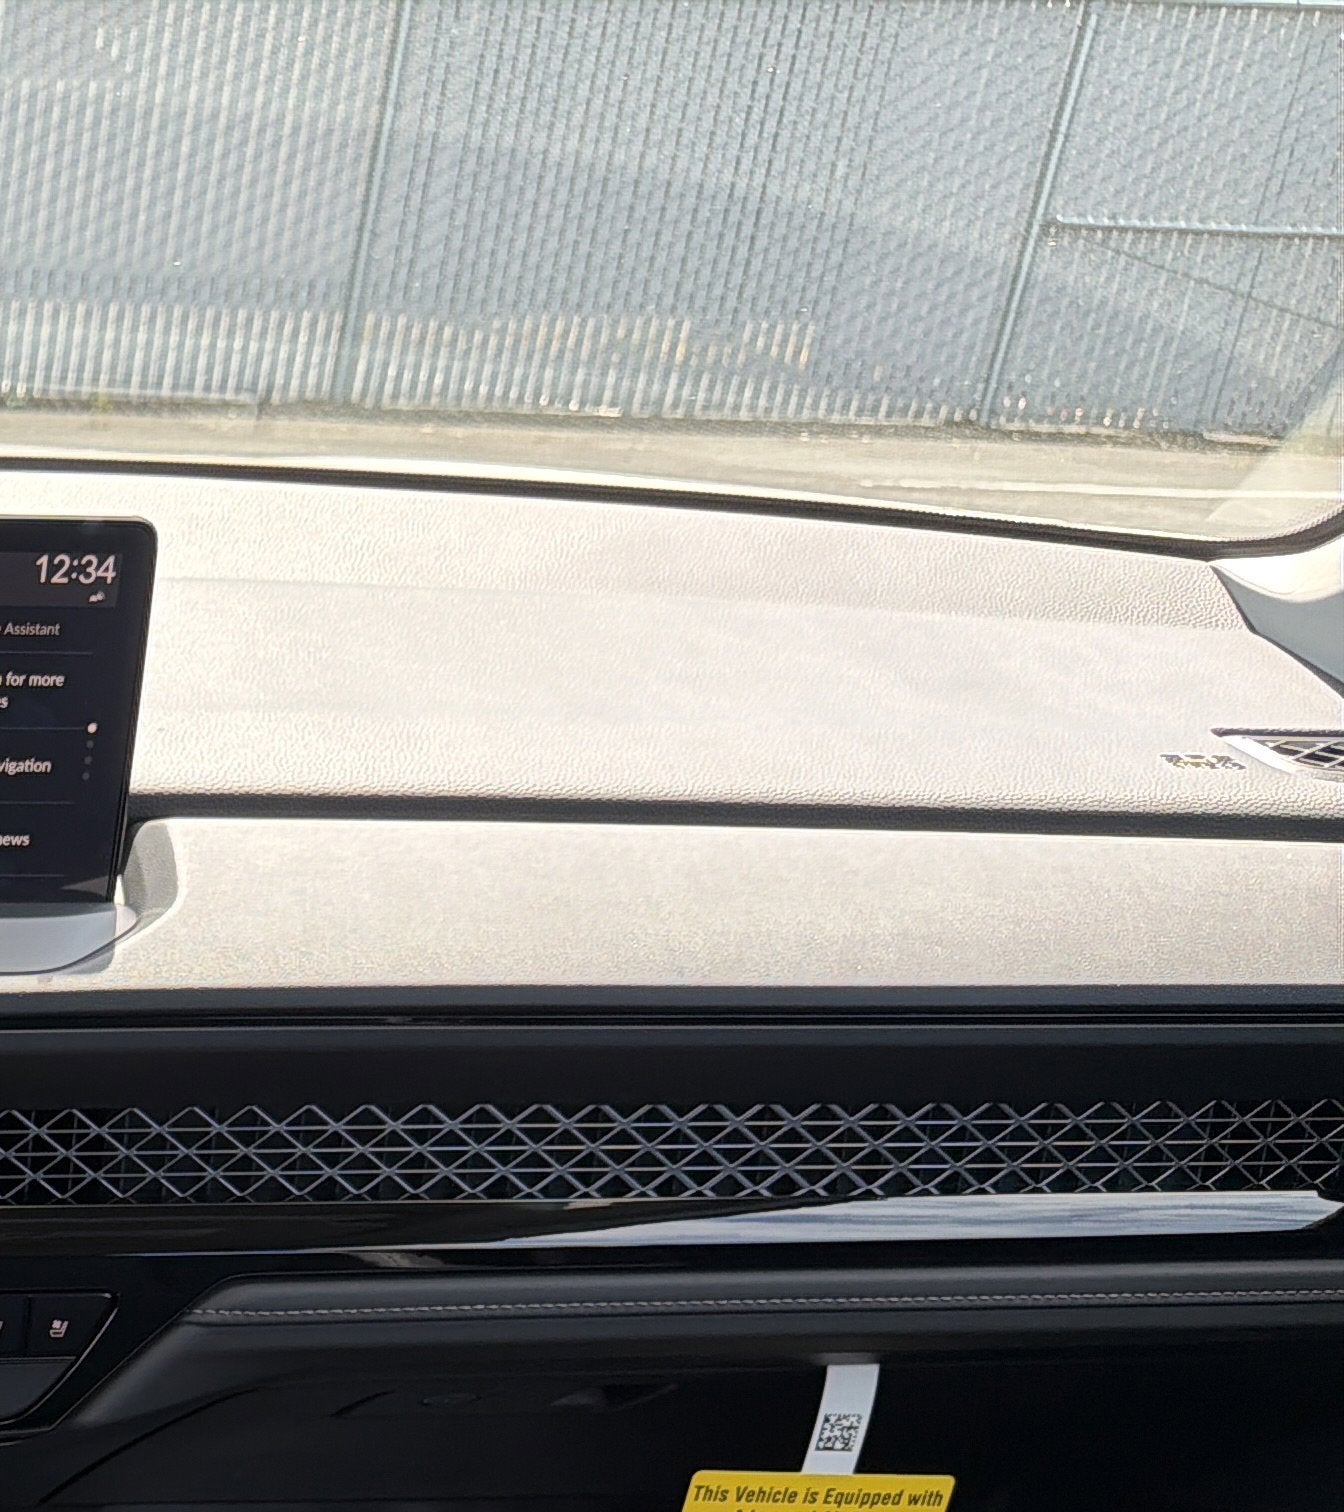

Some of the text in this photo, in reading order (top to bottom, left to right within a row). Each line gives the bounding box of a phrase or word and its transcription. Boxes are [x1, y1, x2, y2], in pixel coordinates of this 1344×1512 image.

[35, 554, 117, 584] 12:34
[4, 622, 60, 636] Assistant
[6, 672, 26, 686] for
[29, 674, 65, 687] more
[694, 1485, 944, 1509] This Vehicle is Equipped with
